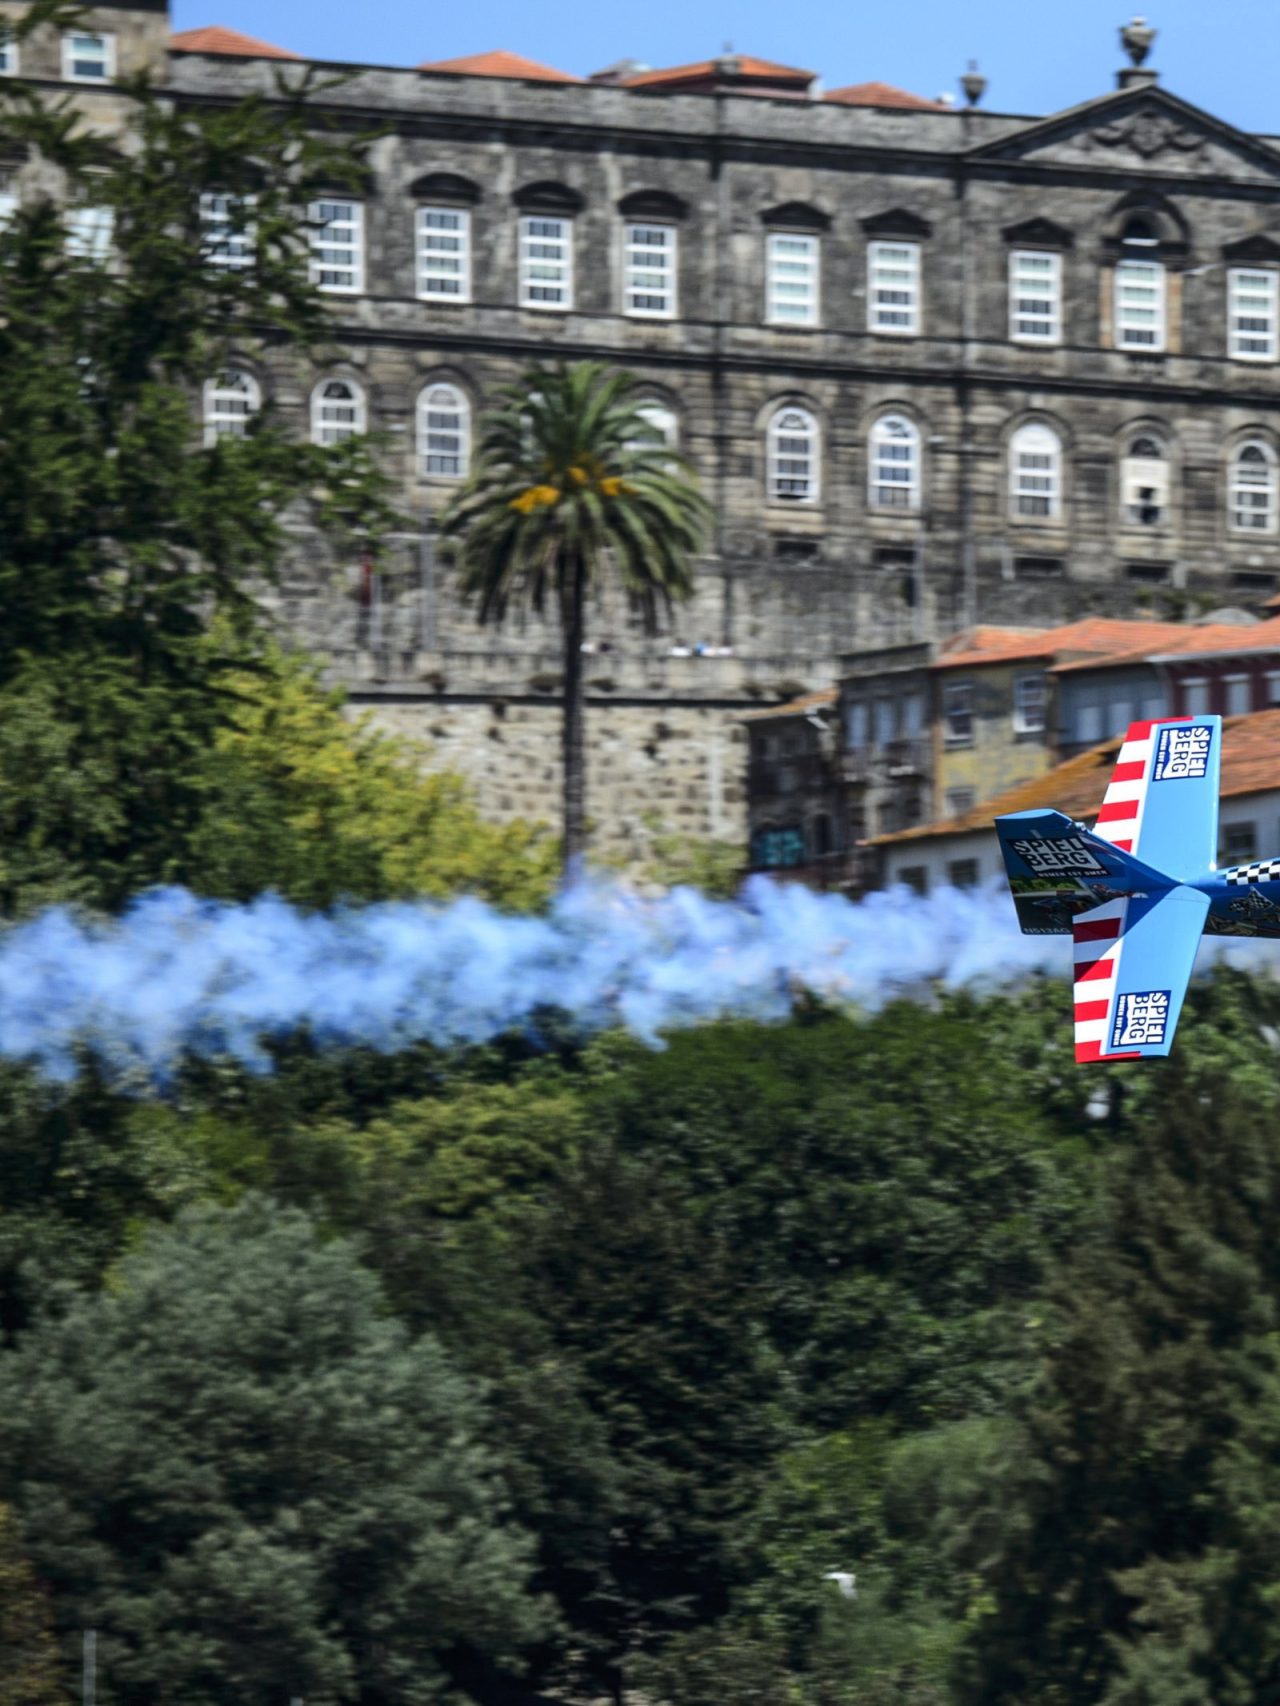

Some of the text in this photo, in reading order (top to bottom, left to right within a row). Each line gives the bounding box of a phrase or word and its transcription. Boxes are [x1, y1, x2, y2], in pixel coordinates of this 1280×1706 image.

[1172, 730, 1192, 773] BERG
[1188, 727, 1209, 776] SPIEL
[1013, 838, 1086, 853] SPIEL
[1022, 852, 1092, 867] BERG
[1129, 996, 1150, 1039] BERG
[1146, 992, 1167, 1042] SPIEL
